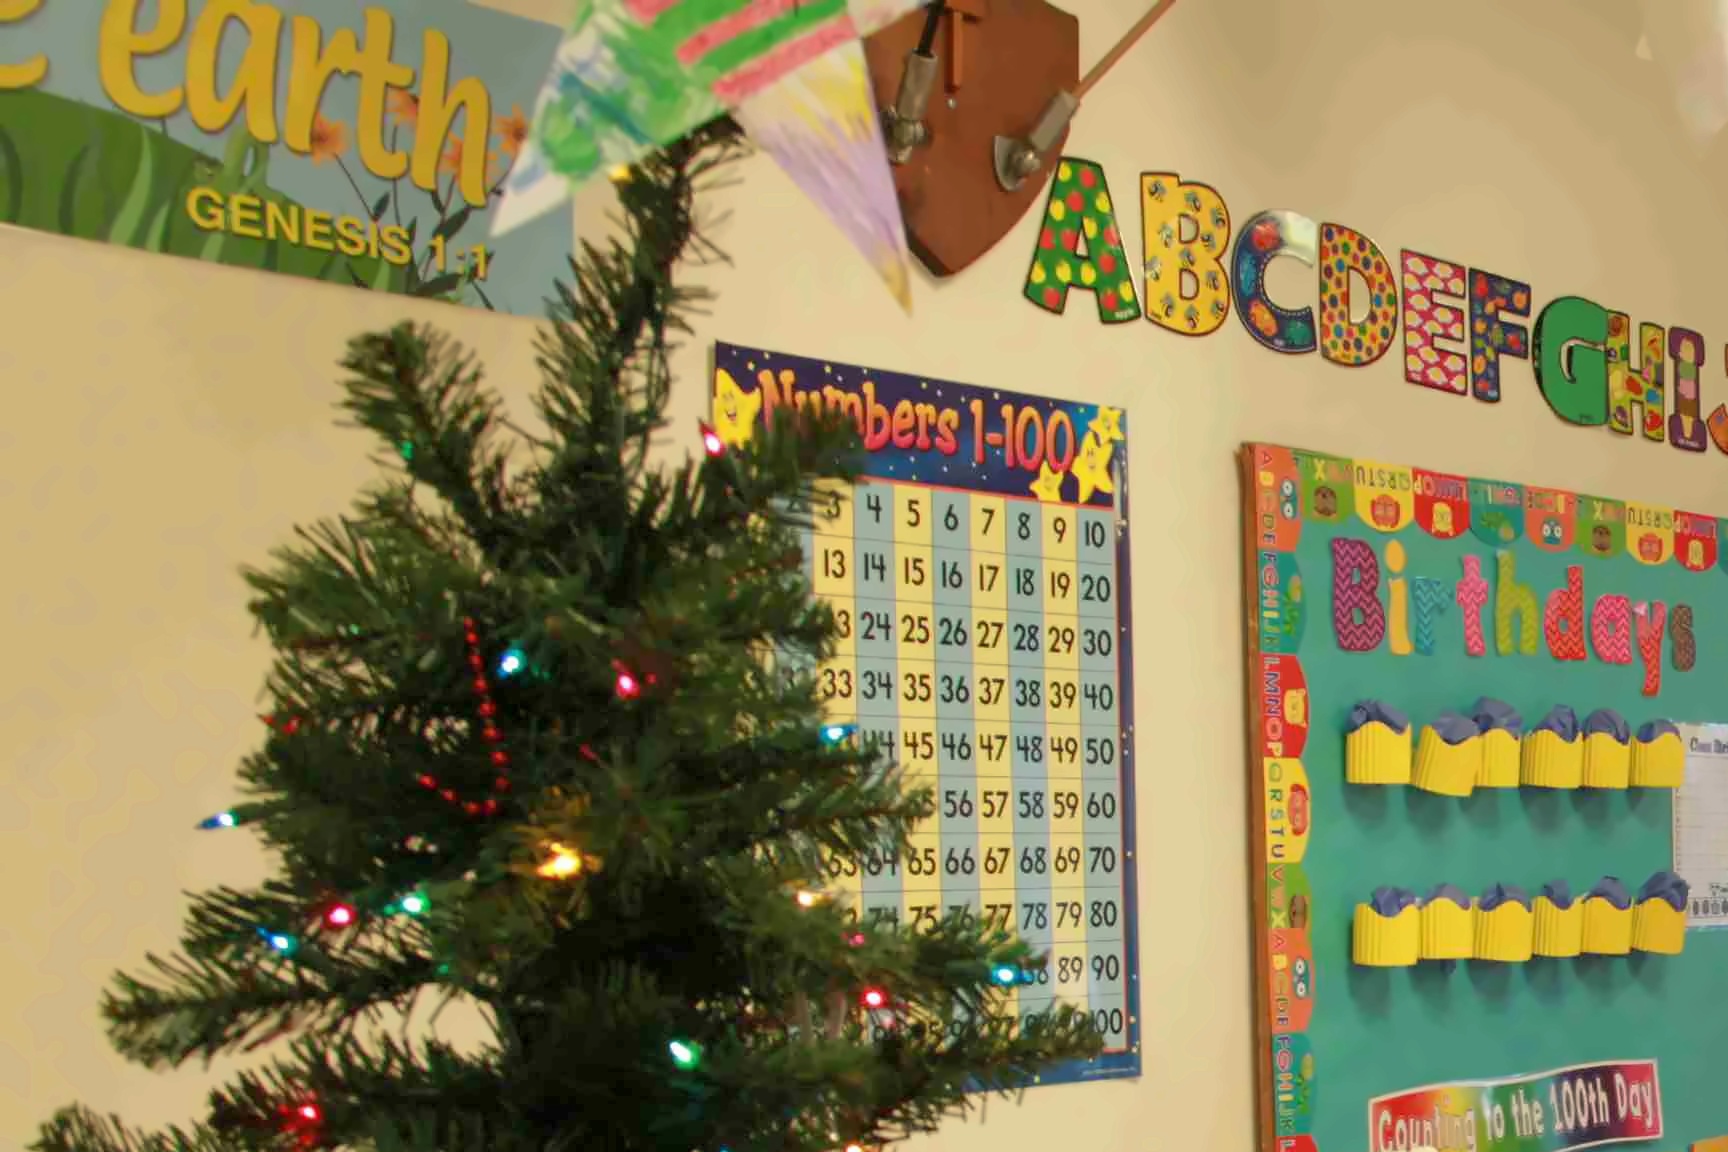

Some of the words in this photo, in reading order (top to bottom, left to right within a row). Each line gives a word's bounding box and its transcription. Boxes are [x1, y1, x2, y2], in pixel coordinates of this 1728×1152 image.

[99, 0, 490, 206] earth
[186, 184, 412, 266] GENESIS
[430, 236, 490, 280] 1:1
[970, 399, 1075, 473] 1-100
[866, 494, 882, 522] 4
[907, 500, 921, 527] 5
[944, 504, 959, 531] 6
[981, 508, 995, 536] 7
[1018, 513, 1031, 540] 8
[1052, 517, 1067, 543] 9
[1084, 521, 1105, 549] 10
[823, 549, 846, 579] 13
[863, 553, 885, 582] 14
[903, 558, 925, 586] 15
[941, 561, 963, 589] 16
[978, 564, 1000, 592] 17
[1015, 568, 1035, 596] 18
[1050, 572, 1071, 599] 19
[1082, 575, 1110, 602] 20
[860, 612, 892, 641] 24
[901, 615, 930, 644] 25
[939, 618, 968, 647] 26
[976, 621, 1003, 649] 27
[1013, 623, 1039, 651] 28
[1048, 626, 1075, 654] 29
[1083, 629, 1111, 656] 30
[1332, 537, 1697, 697] Birthdays
[823, 668, 853, 697] 33
[862, 672, 892, 700] 34
[903, 674, 932, 703] 35
[940, 676, 970, 703] 36
[978, 678, 1005, 705] 37
[1014, 680, 1040, 707] 38
[1050, 682, 1076, 708] 39
[1084, 683, 1113, 710] 40
[904, 731, 934, 760] 45
[941, 732, 971, 761] 46
[979, 734, 1008, 761] 47
[1016, 735, 1043, 763] 48
[1050, 736, 1078, 763] 49
[1085, 737, 1114, 765] 50
[944, 790, 973, 818] 56
[982, 791, 1008, 818] 57
[1018, 792, 1044, 818] 58
[1053, 792, 1079, 818] 59
[1087, 792, 1115, 818] 60
[908, 848, 936, 876] 65
[945, 848, 975, 875] 66
[984, 847, 1010, 875] 67
[1020, 847, 1046, 874] 68
[1054, 846, 1080, 873] 69
[1089, 846, 1115, 873] 70
[1023, 903, 1047, 930] 78
[1056, 901, 1081, 928] 79
[1091, 900, 1117, 927] 80
[1058, 956, 1083, 983] 89
[1093, 954, 1119, 981] 90
[1511, 1087, 1545, 1138] the
[1549, 1077, 1610, 1133] 100th
[1615, 1073, 1655, 1127] Day
